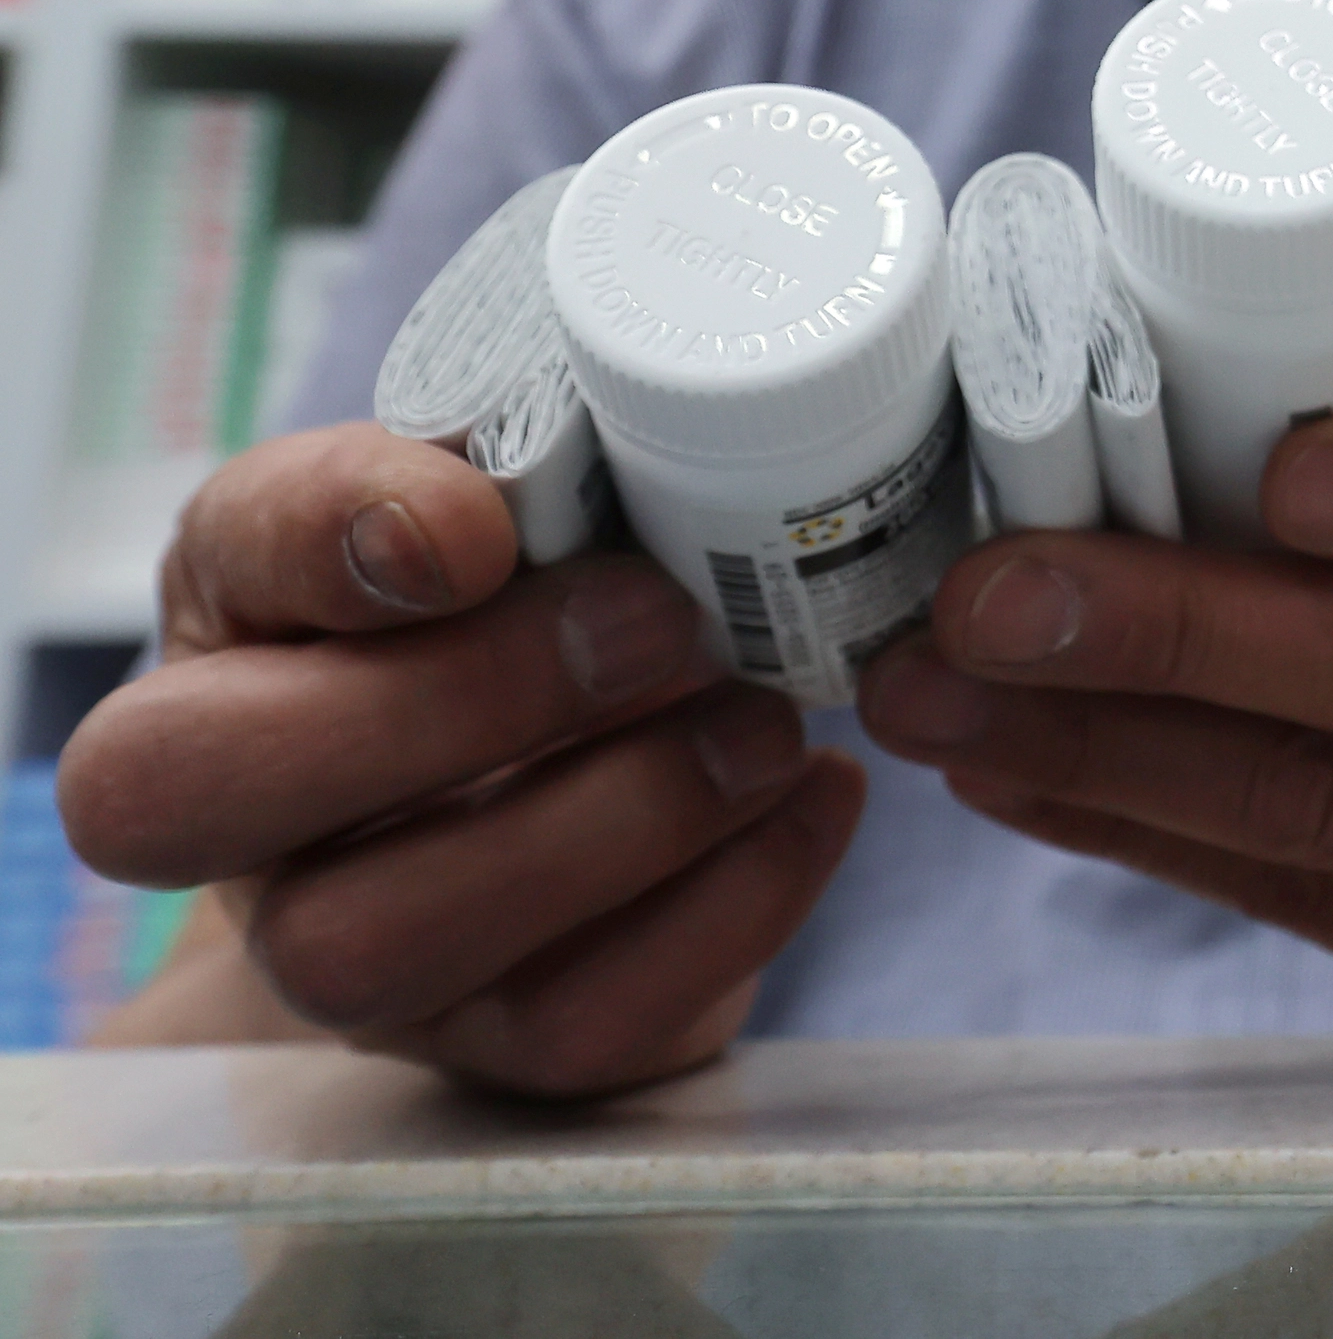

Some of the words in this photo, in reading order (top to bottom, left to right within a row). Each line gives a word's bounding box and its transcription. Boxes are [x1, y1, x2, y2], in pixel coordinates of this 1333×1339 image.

[748, 103, 799, 132] TO
[807, 111, 899, 182] OPEN
[710, 164, 839, 237] CLOSE
